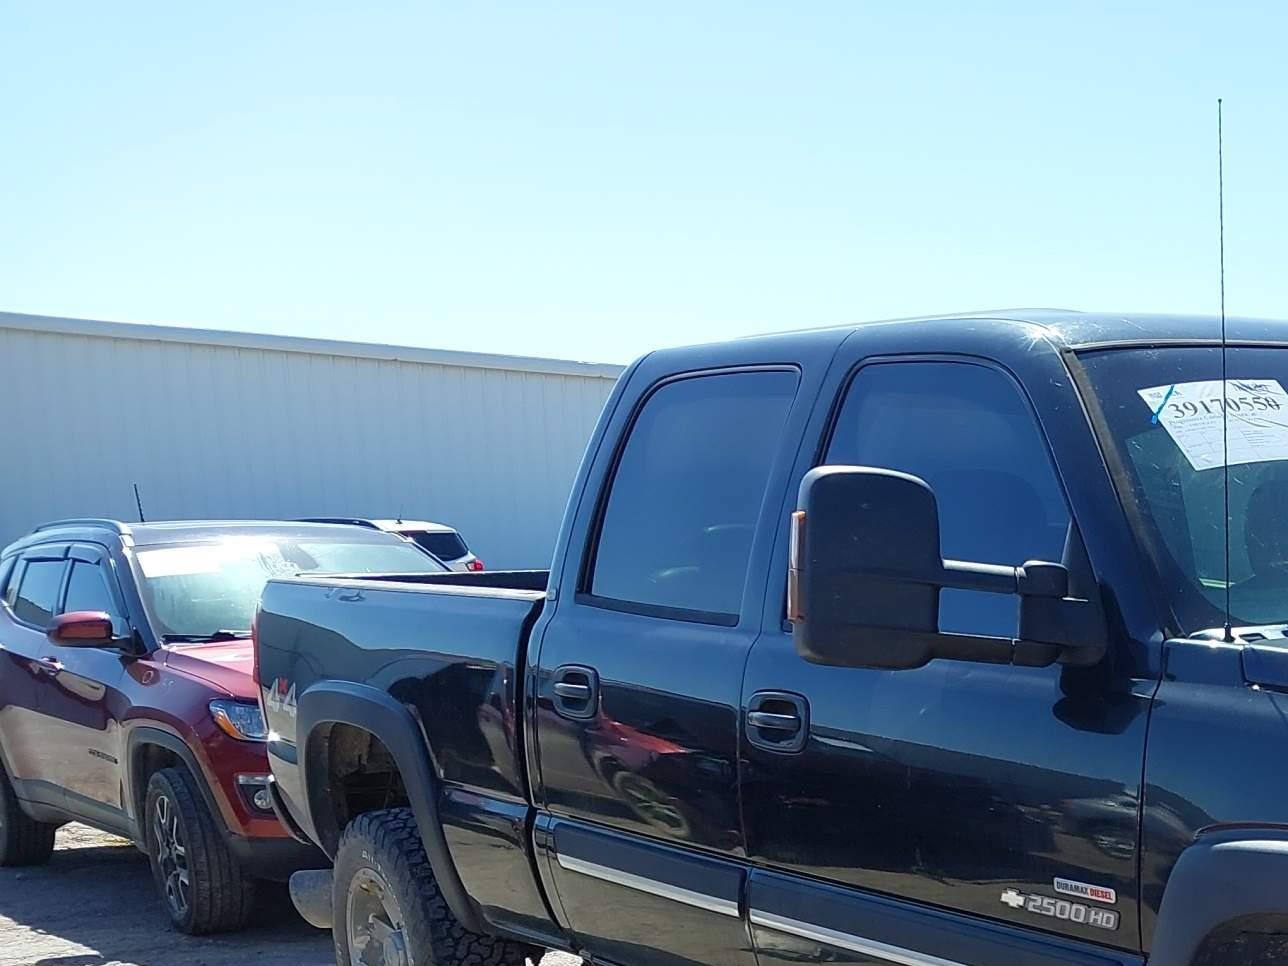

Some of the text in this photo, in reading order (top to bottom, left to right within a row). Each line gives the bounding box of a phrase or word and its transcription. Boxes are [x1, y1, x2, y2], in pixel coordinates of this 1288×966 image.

[1056, 880, 1114, 901] DURAMAX DIESEL
[1026, 893, 1116, 929] 2500 HD
